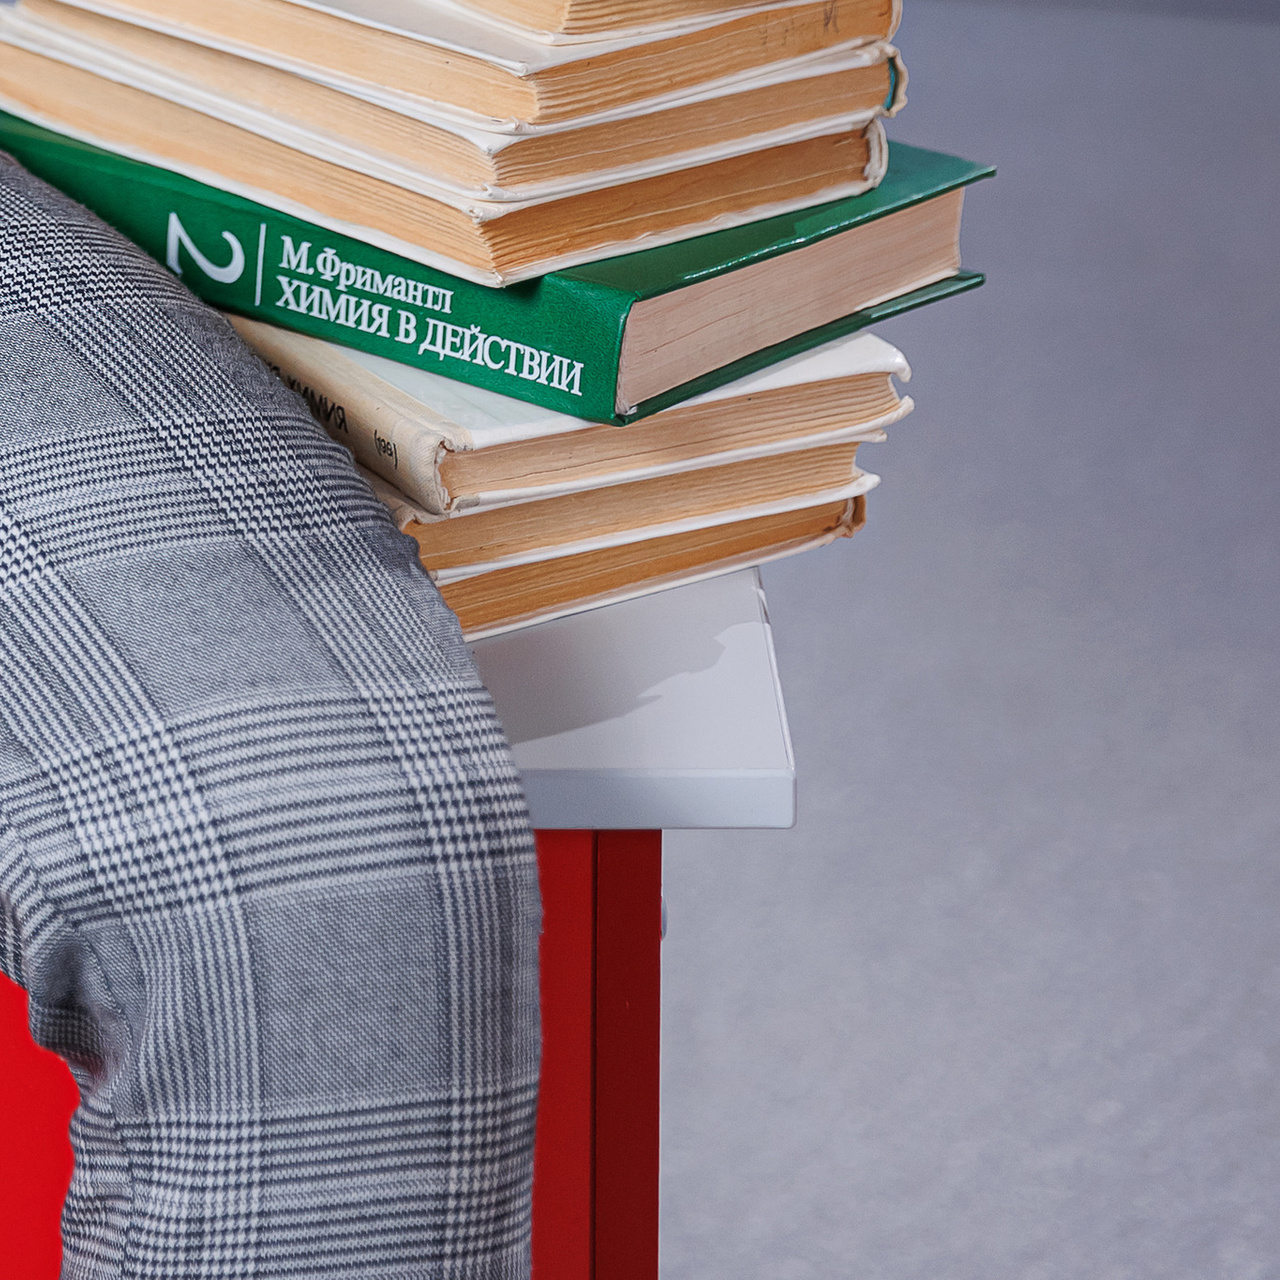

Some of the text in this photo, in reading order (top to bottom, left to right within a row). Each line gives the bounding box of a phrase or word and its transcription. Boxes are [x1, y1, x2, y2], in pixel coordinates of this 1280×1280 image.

[166, 211, 245, 285] 2
[275, 275, 584, 396] ХИМИЯ В ДЕЙСТВИИ
